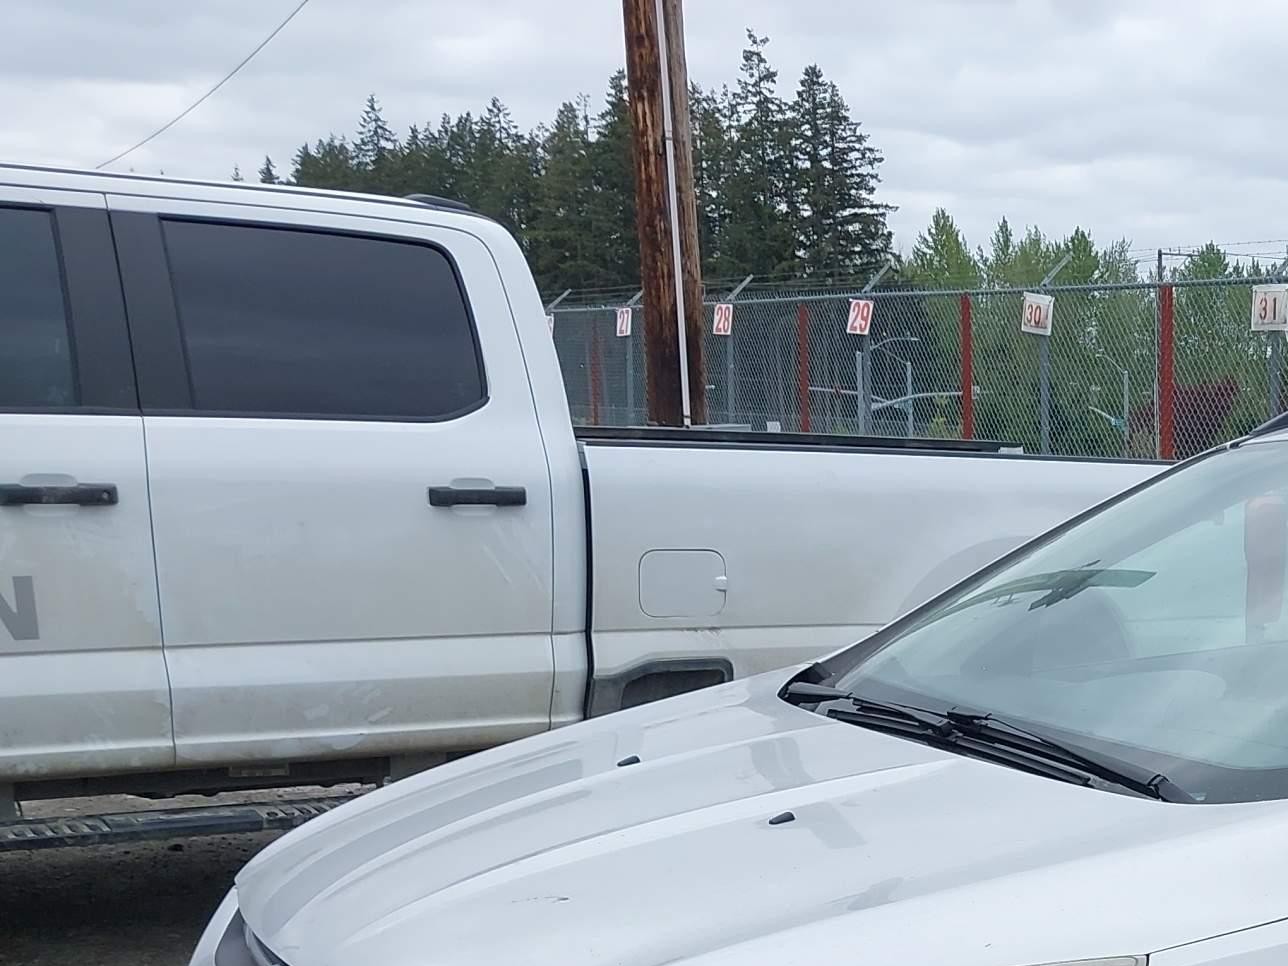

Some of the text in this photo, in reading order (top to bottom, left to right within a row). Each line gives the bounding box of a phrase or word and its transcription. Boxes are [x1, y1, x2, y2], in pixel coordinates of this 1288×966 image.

[715, 305, 731, 333] 28
[850, 302, 870, 332] 29
[1027, 303, 1041, 325] 30
[1259, 296, 1277, 320] 31
[618, 309, 630, 335] 27
